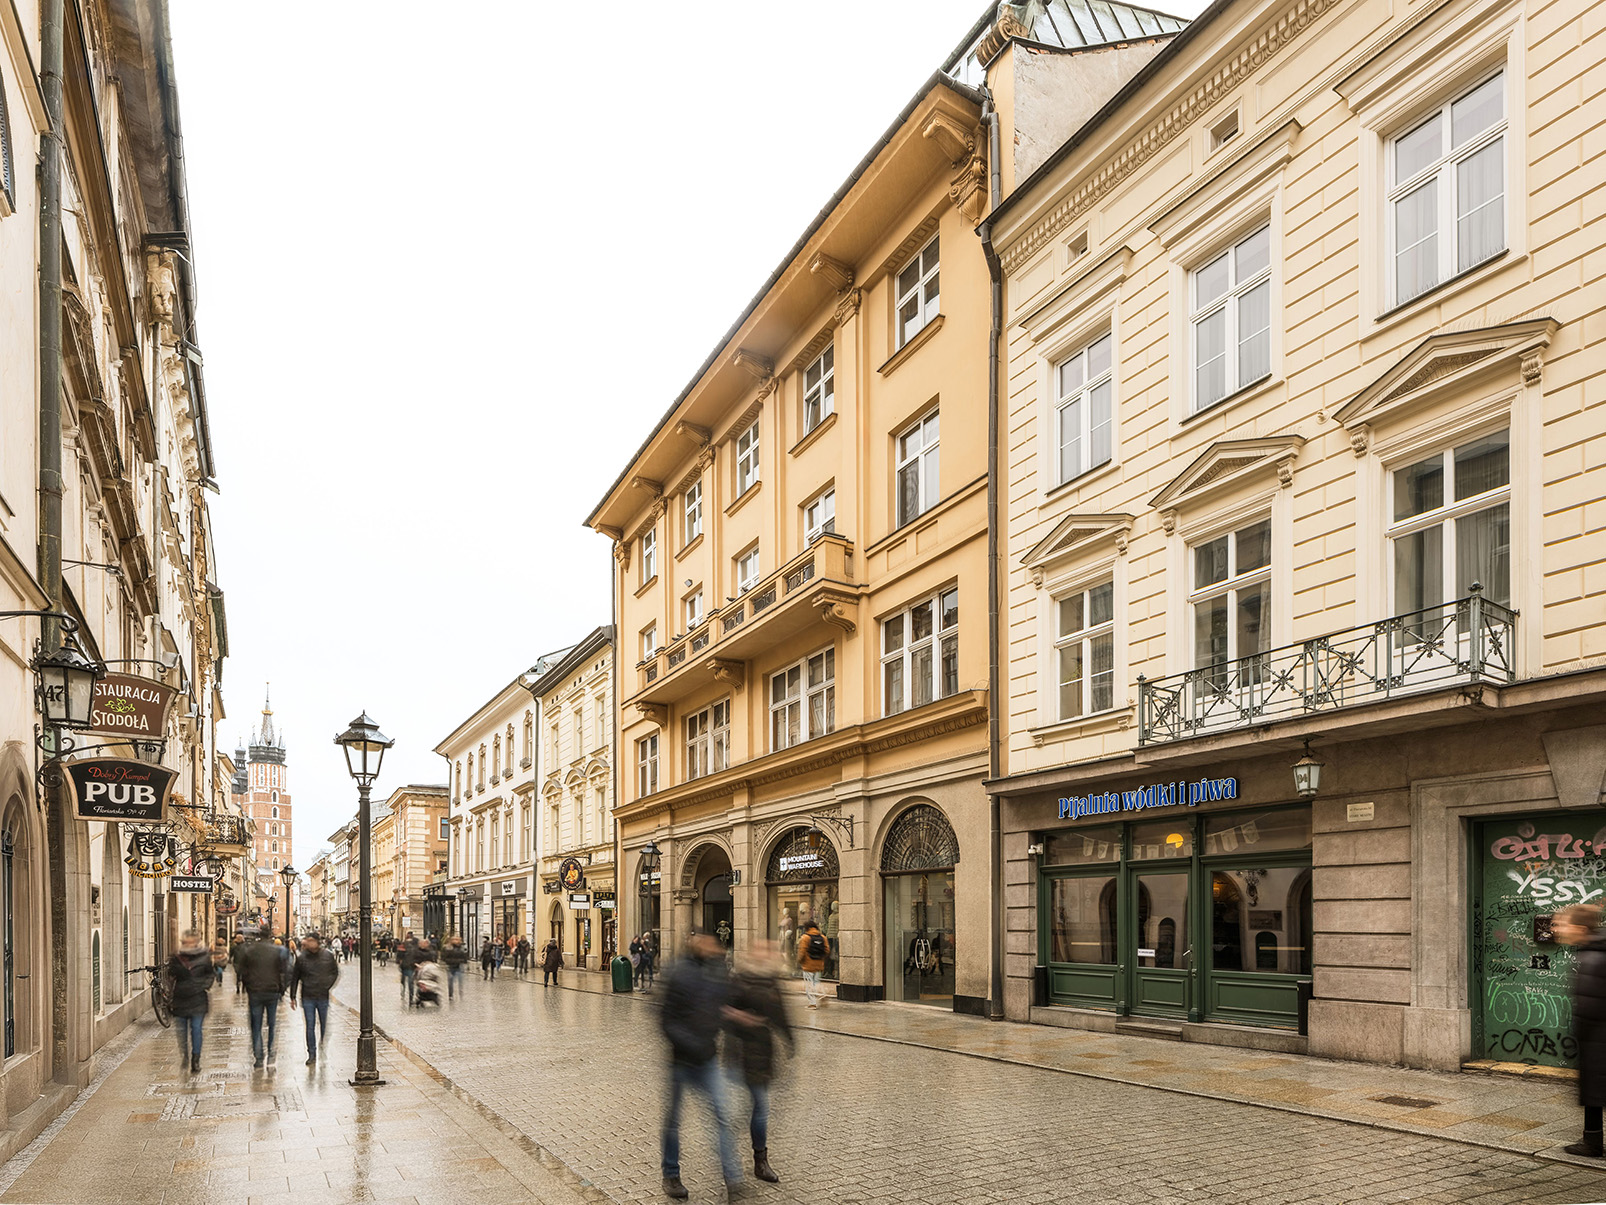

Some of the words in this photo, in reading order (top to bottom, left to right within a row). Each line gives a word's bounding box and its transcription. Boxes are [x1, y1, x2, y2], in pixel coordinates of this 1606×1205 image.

[45, 685, 65, 702] 47
[78, 683, 161, 705] RSTAURACJA
[92, 709, 150, 731] STODOŁA
[88, 766, 117, 781] Dobry
[114, 766, 151, 782] Kumpel
[84, 781, 157, 805] PUB
[1057, 791, 1120, 820] Pijalnia
[1121, 781, 1177, 811] wódki
[1178, 780, 1186, 805] i
[1188, 776, 1237, 807] piwa
[787, 854, 818, 863] MOUNTAIN
[787, 860, 825, 870] WAREHOUSE
[173, 880, 212, 889] HOSTEL
